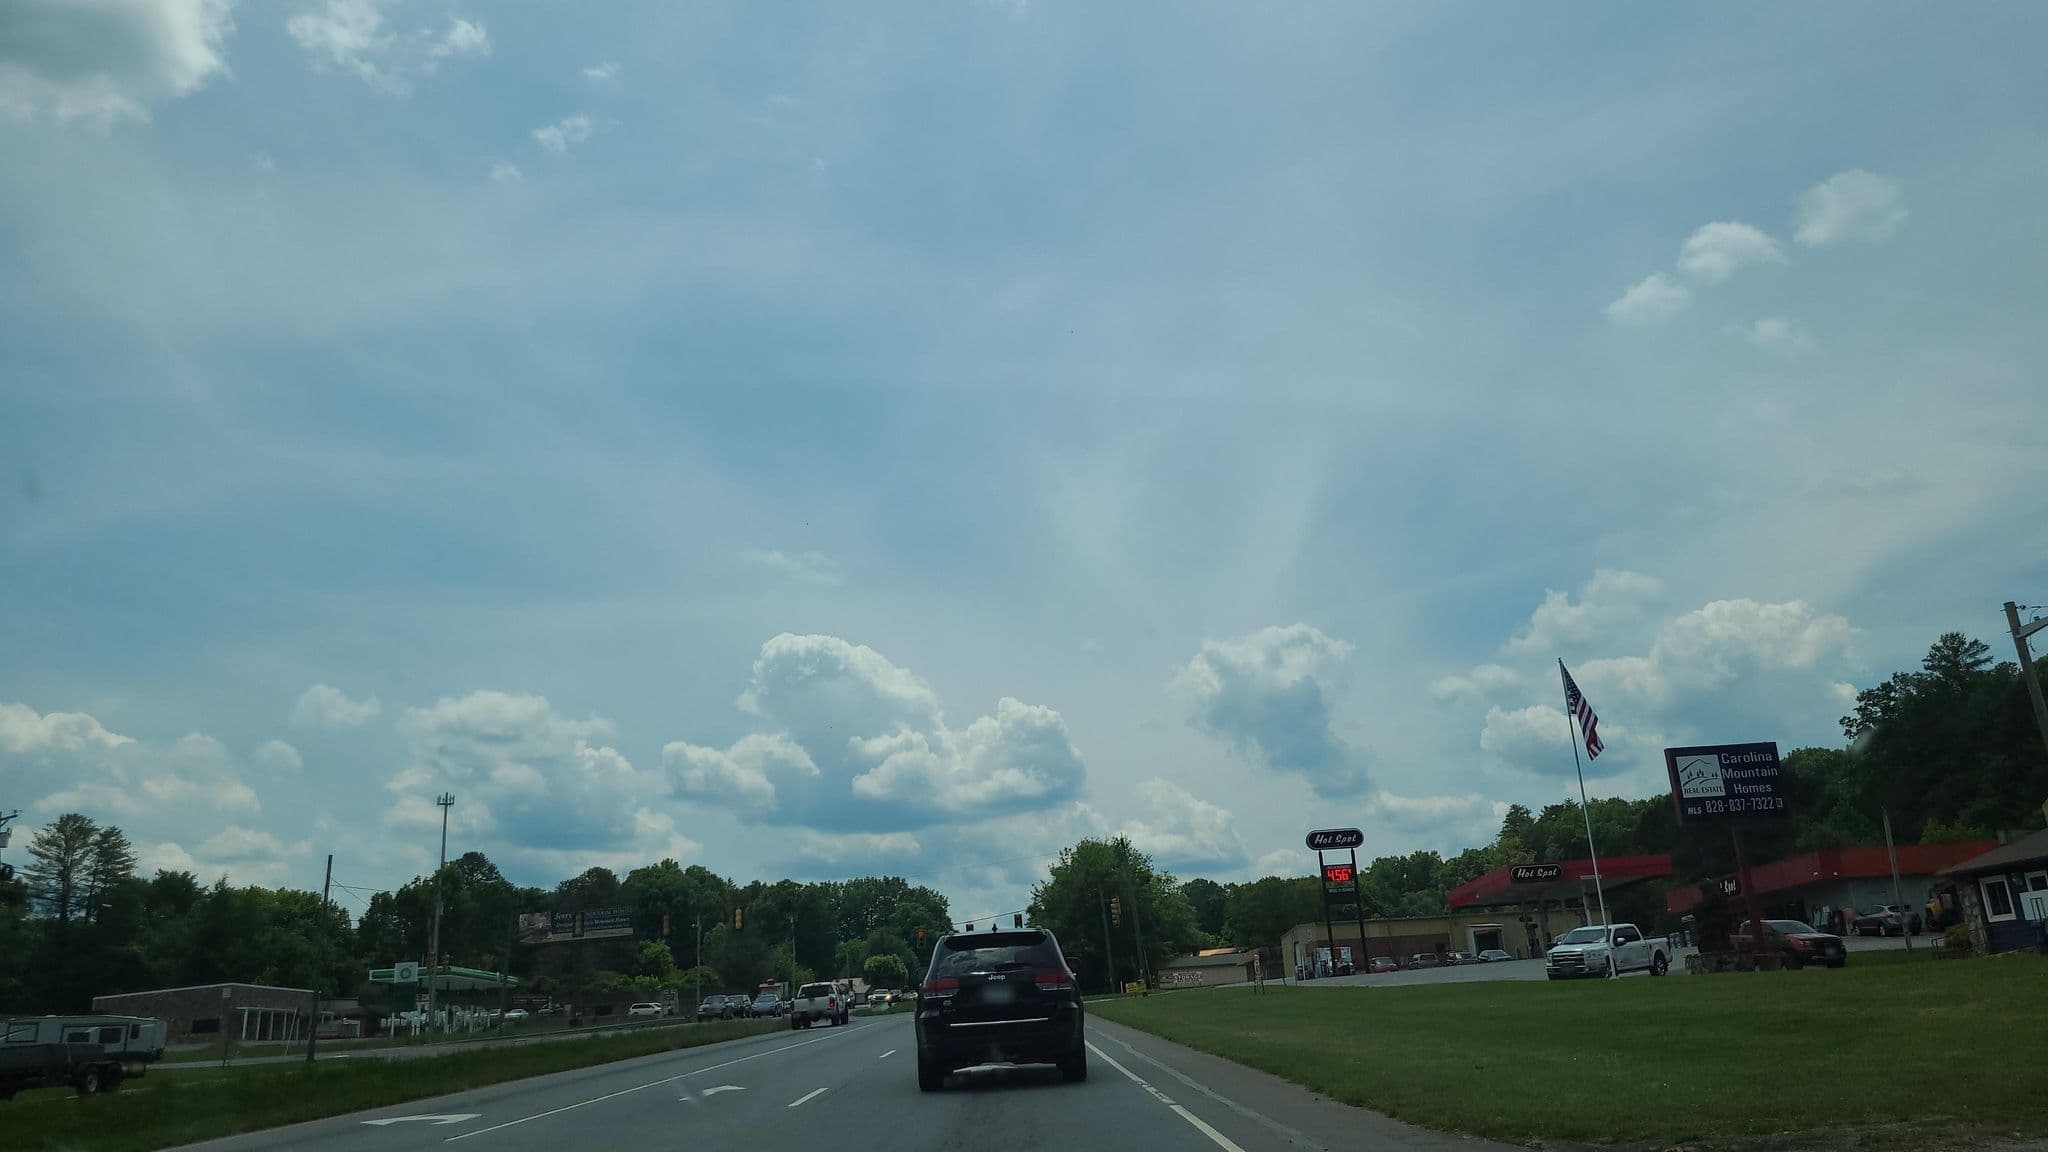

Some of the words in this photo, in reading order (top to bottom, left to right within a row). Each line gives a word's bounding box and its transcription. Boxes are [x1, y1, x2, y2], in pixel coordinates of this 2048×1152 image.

[1721, 751, 1773, 764] Carolina
[1721, 765, 1778, 780] Mountain
[1702, 785, 1724, 794] ESTATE
[1734, 784, 1772, 794] Homes
[1687, 806, 1703, 815] MLS
[1705, 797, 1775, 814] 828-837-7322
[1314, 834, 1332, 844] Hot
[1335, 834, 1357, 844] Spot
[1517, 868, 1534, 878] Hot
[1536, 868, 1557, 878] Spot
[988, 973, 1006, 982] Jeep
